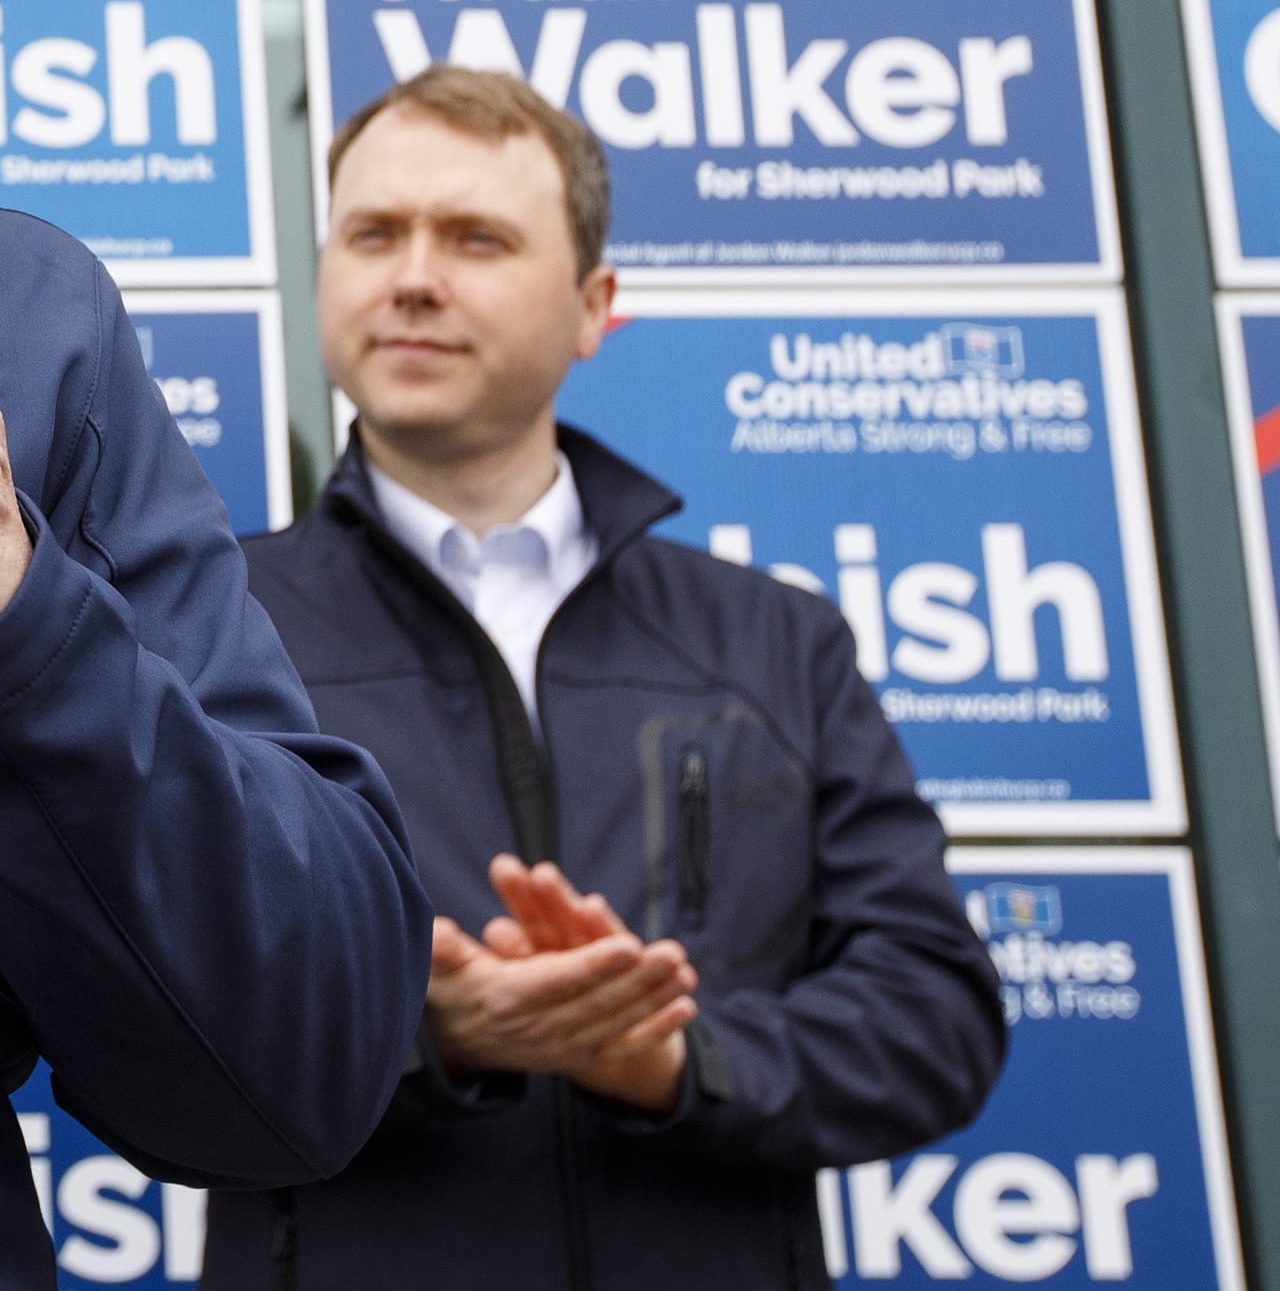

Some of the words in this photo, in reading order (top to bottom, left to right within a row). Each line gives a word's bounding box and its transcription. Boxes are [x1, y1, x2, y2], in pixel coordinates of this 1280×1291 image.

[0, 155, 134, 185] Sherwood
[138, 154, 214, 183] Park
[696, 160, 752, 200] for
[755, 159, 949, 199] Sherwood
[953, 159, 1043, 197] Park
[770, 332, 943, 382] United
[726, 372, 1086, 419] Conservatives
[731, 418, 857, 452] Alberta
[860, 419, 977, 460] Strong
[982, 419, 1008, 451] &
[1013, 418, 1091, 451] Free
[880, 689, 1035, 722] Sherwood
[1036, 688, 1108, 722] Park
[1056, 981, 1140, 1018] Free
